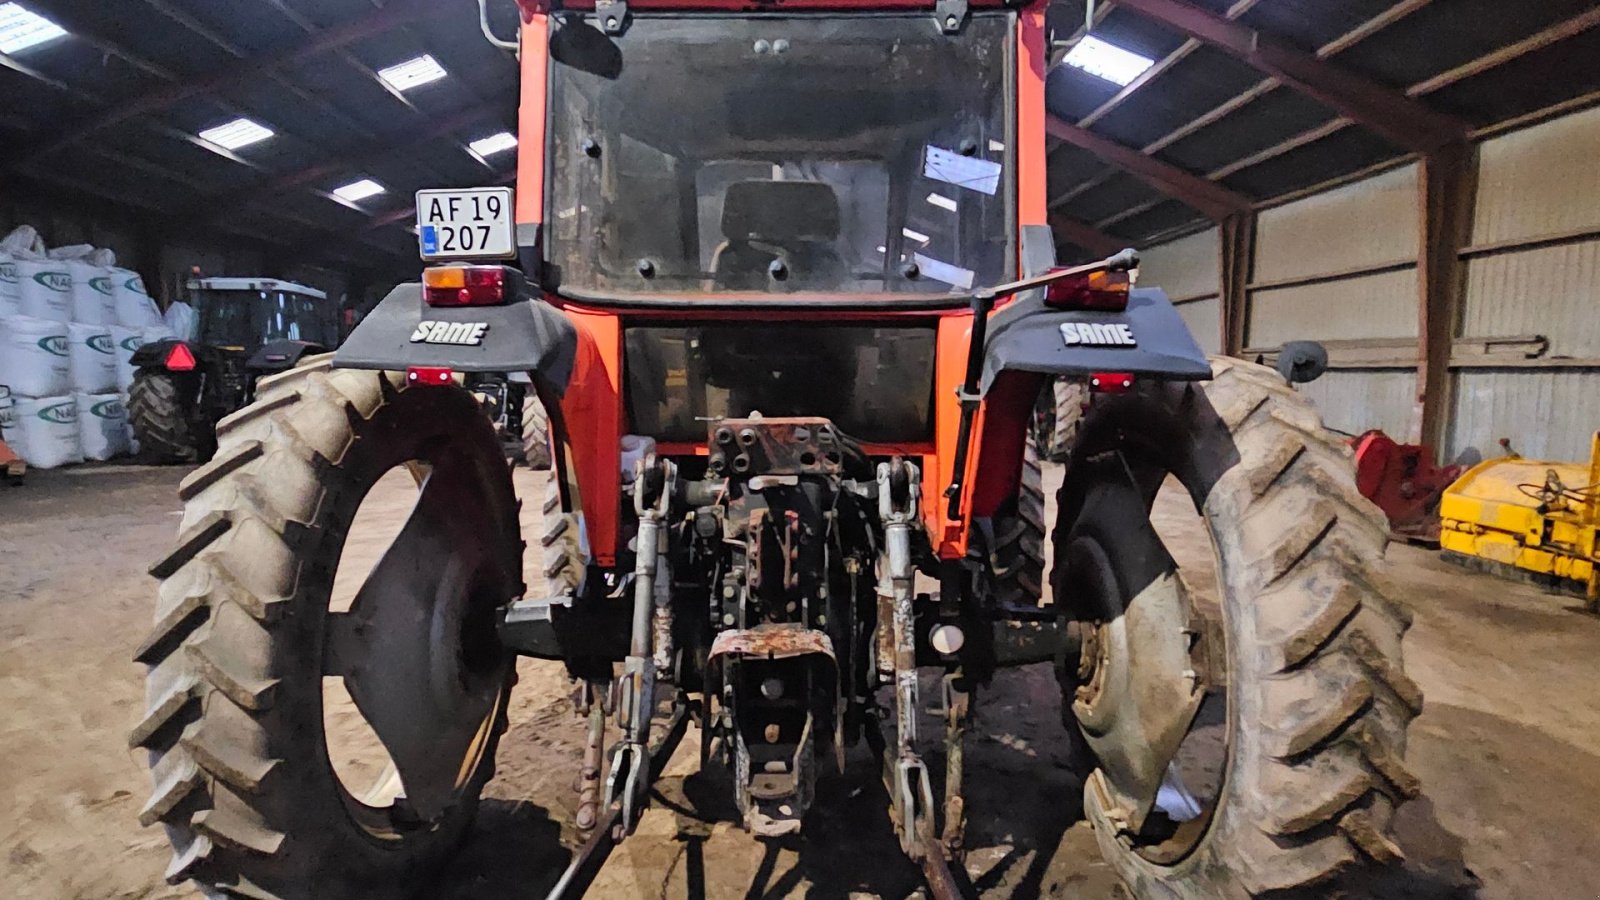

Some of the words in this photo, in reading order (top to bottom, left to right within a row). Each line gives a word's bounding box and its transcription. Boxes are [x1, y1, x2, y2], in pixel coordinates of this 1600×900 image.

[429, 197, 461, 222] AF
[471, 196, 501, 221] 19
[441, 225, 491, 251] 207
[409, 320, 488, 345] SAME
[1060, 322, 1136, 346] SAME
